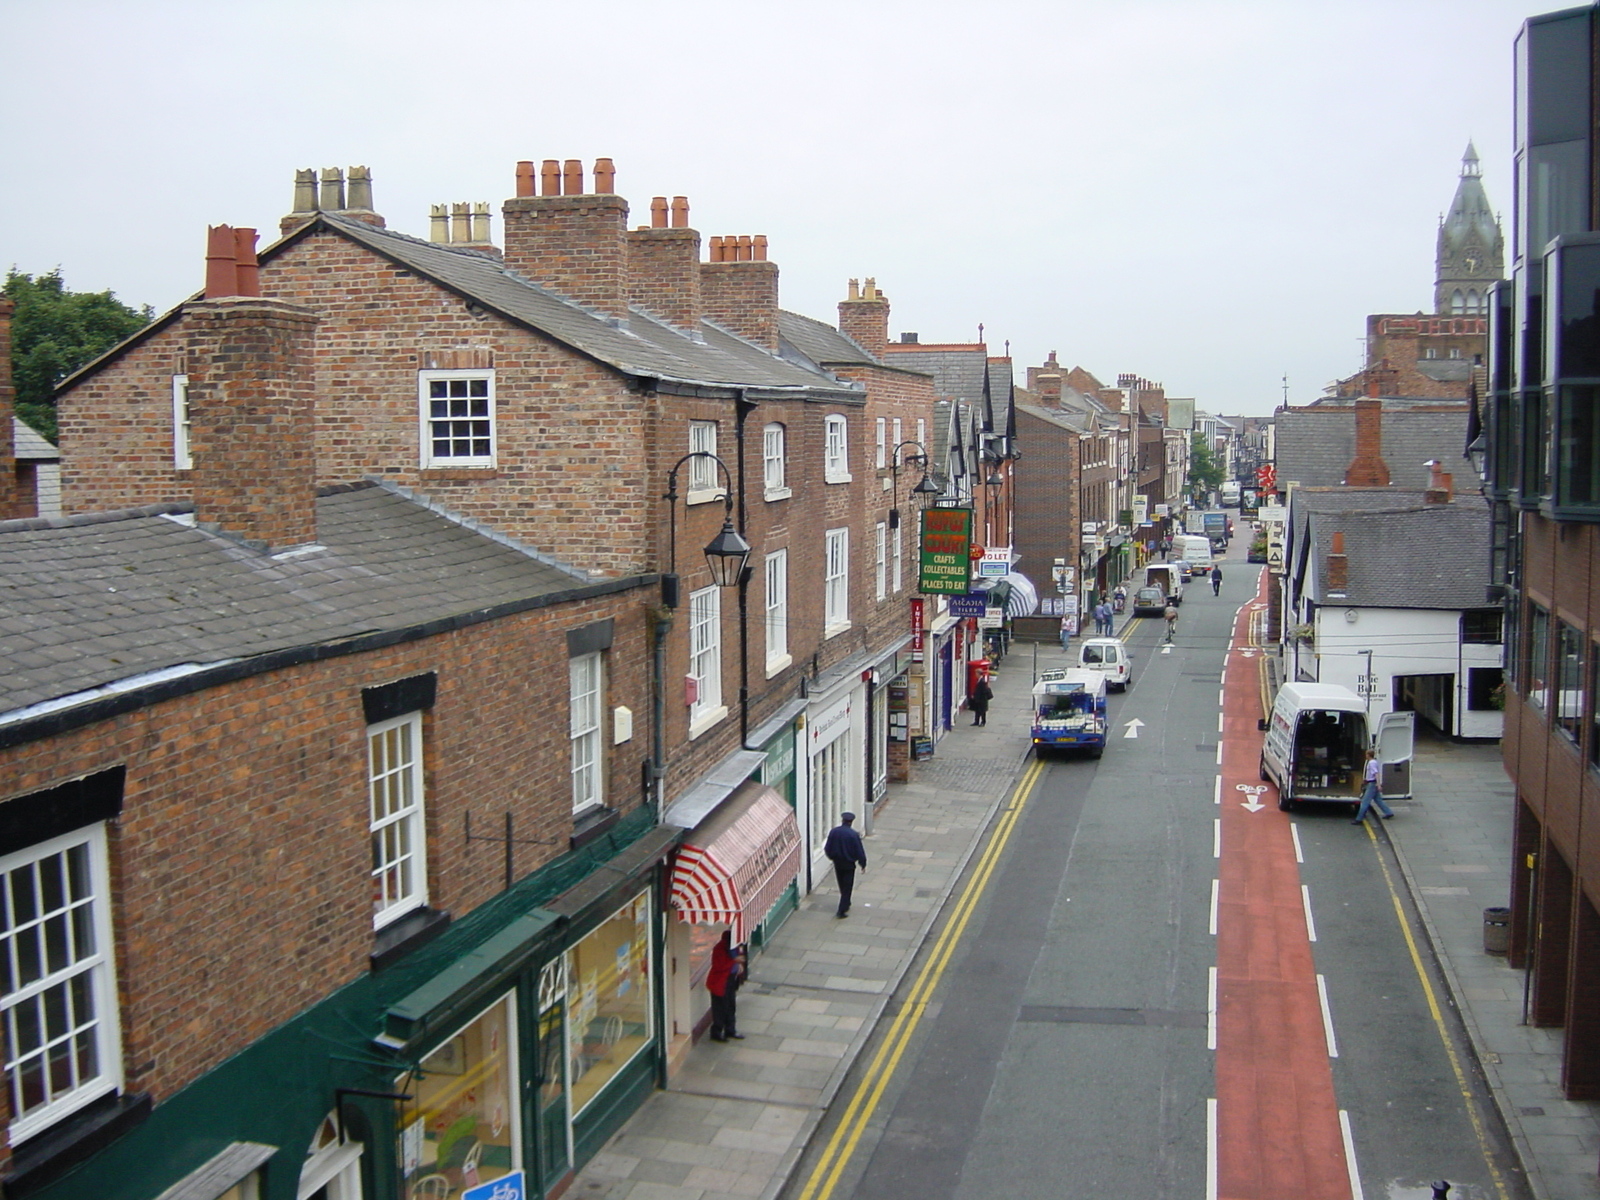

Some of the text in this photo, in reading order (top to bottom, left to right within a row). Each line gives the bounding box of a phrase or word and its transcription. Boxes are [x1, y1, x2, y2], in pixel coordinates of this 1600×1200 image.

[924, 534, 966, 554] COURT
[934, 555, 955, 564] CRAFTS
[923, 564, 965, 575] COLLECTABLES
[922, 580, 966, 590] PLACES TO EAT
